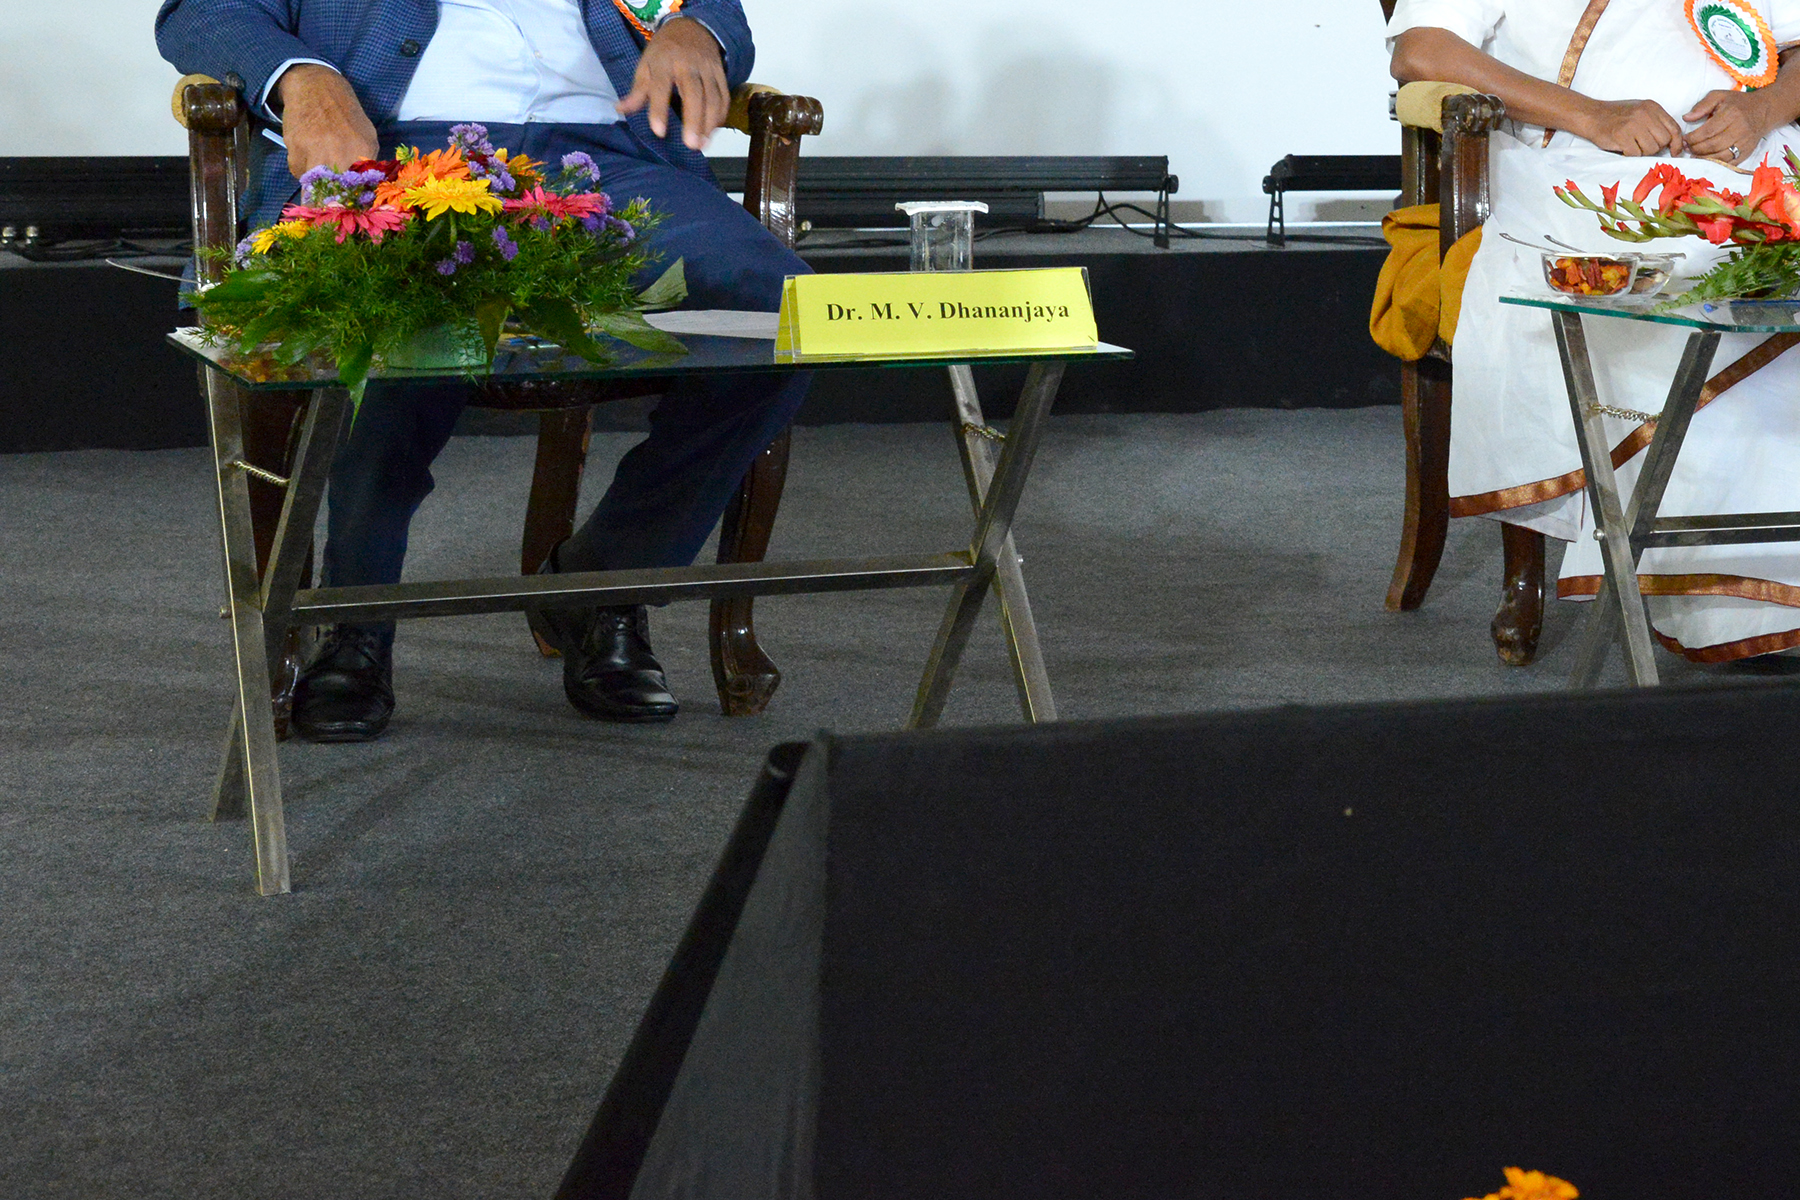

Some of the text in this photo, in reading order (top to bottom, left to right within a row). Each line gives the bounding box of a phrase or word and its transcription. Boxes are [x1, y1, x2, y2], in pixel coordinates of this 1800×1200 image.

[826, 300, 1070, 323] Dr. M. V. Dhananjaya
